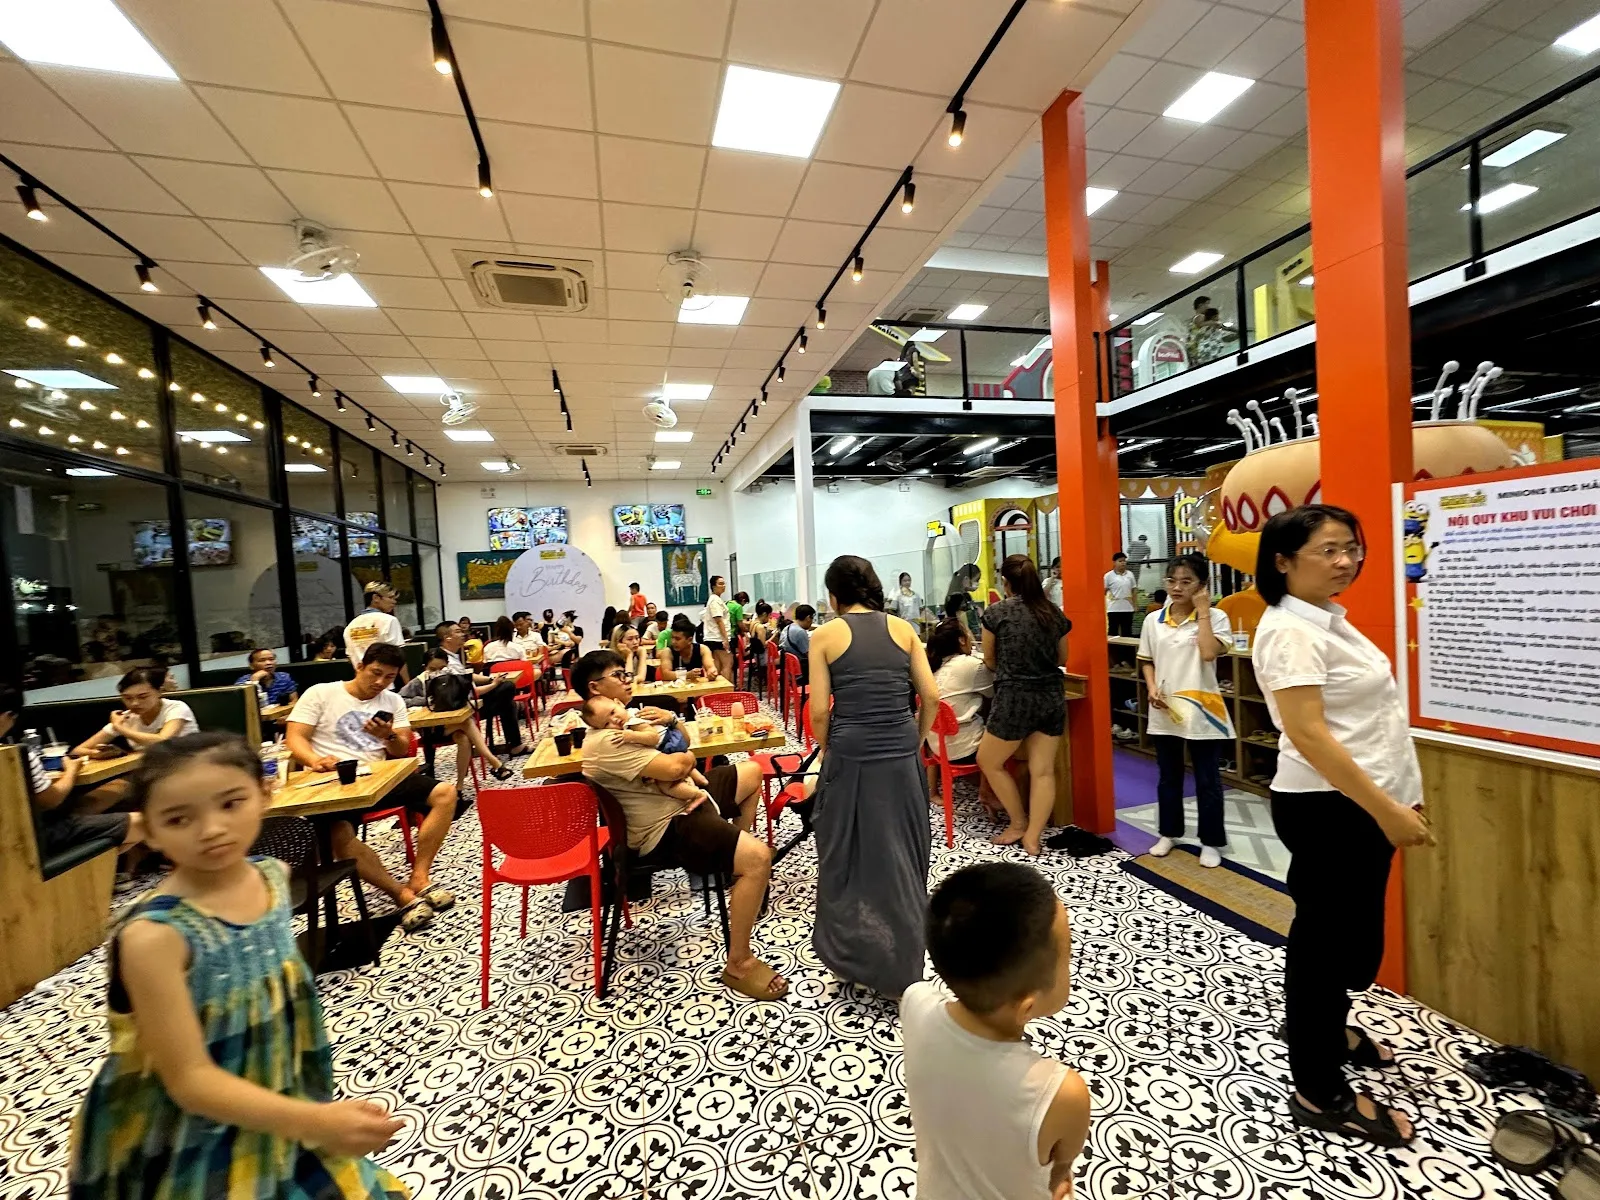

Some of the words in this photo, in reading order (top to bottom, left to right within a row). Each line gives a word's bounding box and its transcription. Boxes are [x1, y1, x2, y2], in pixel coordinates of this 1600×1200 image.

[1550, 484, 1578, 494] KIDS
[1448, 514, 1469, 528] NỘI
[1473, 512, 1497, 525] QUY
[1501, 510, 1528, 522] KHU
[1532, 508, 1555, 520] VUI
[1561, 503, 1596, 517] CHƠI
[520, 567, 587, 597] Birthday
